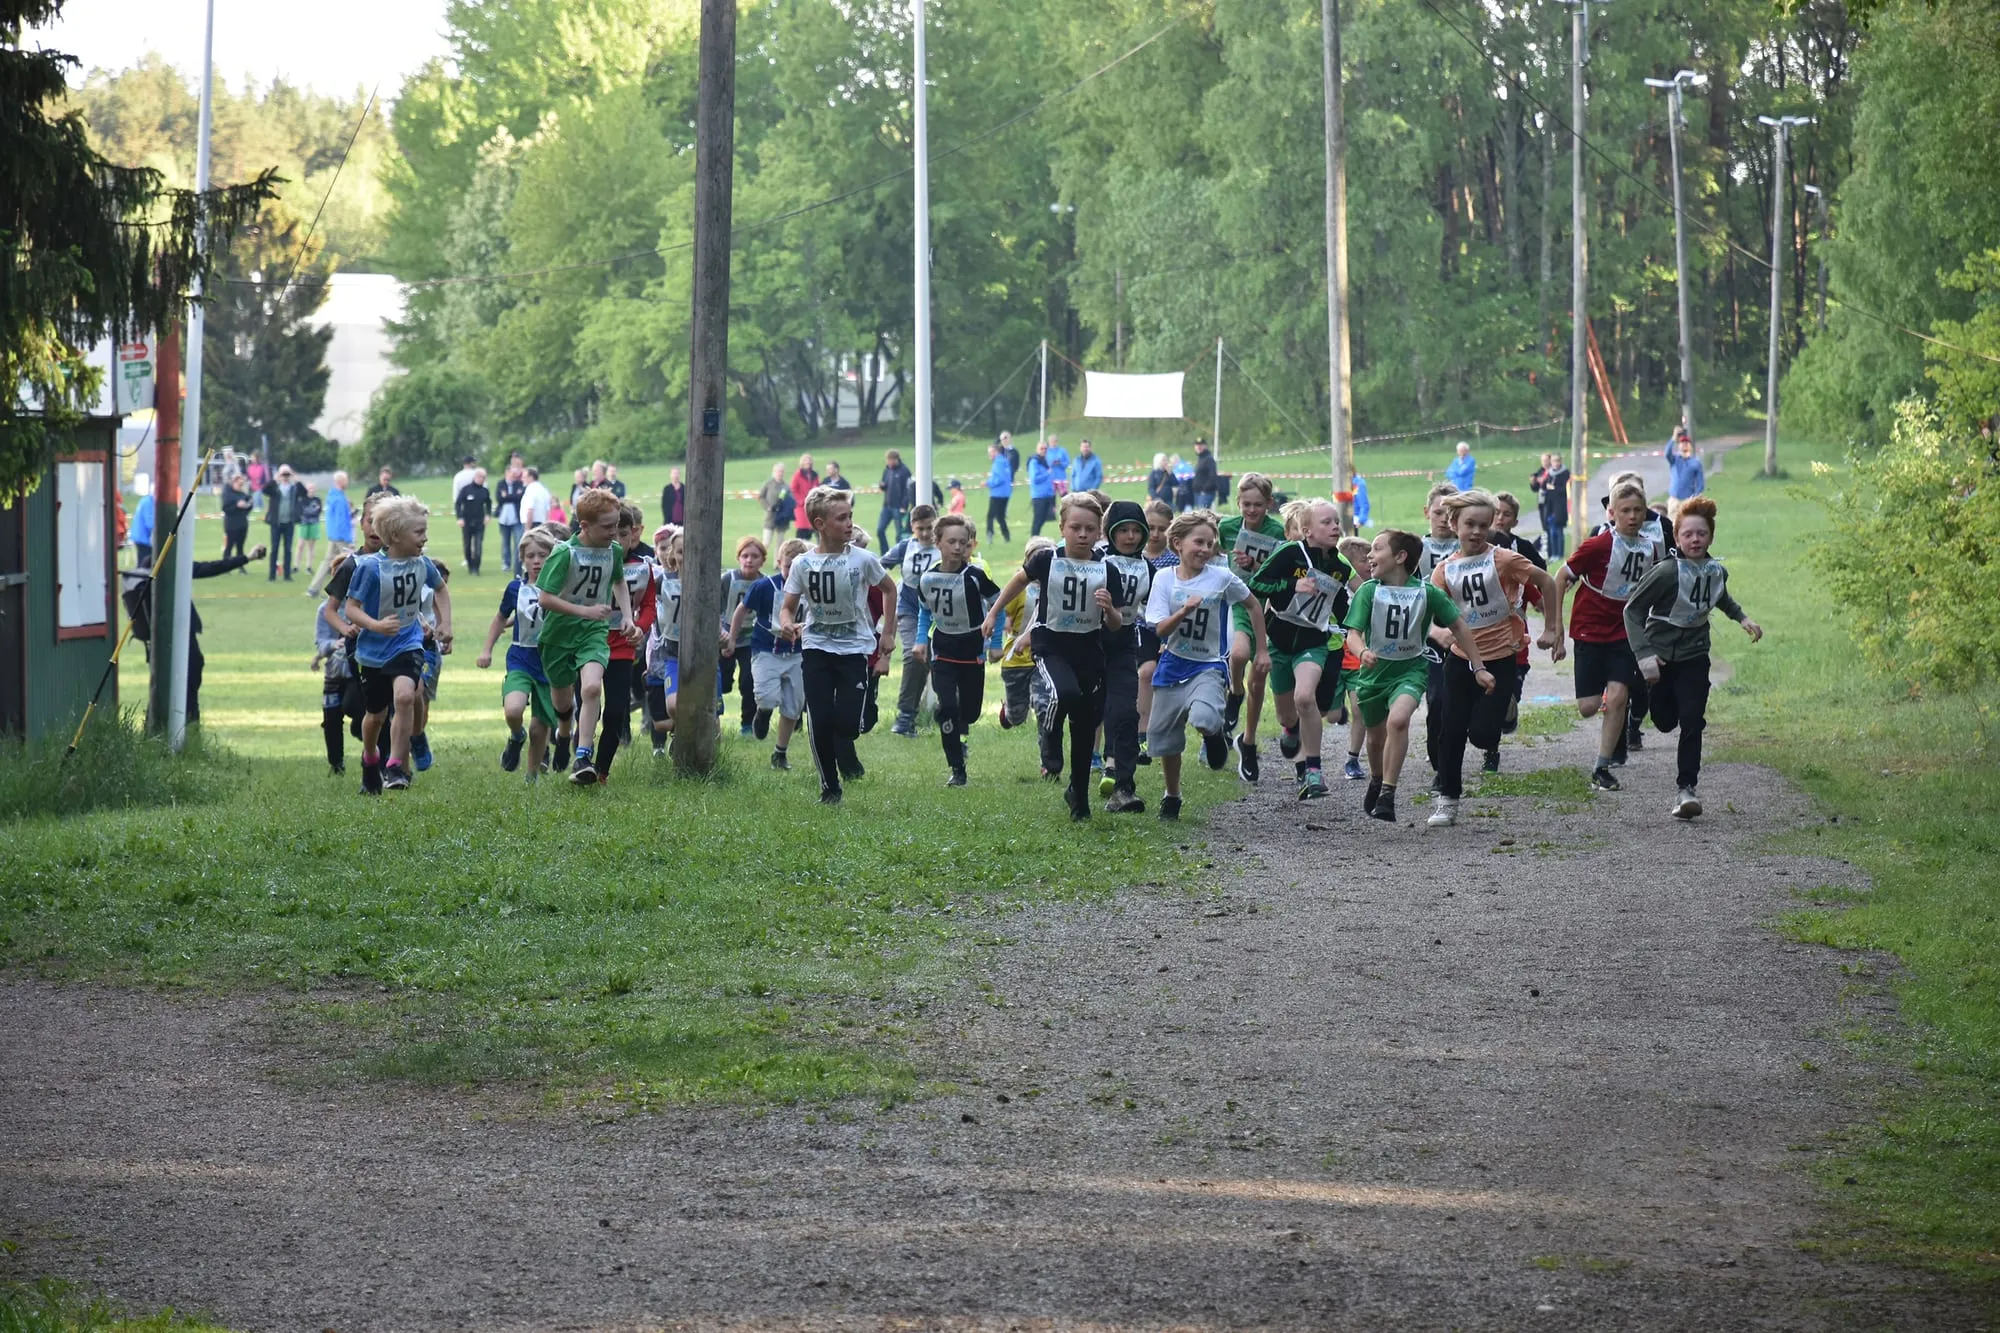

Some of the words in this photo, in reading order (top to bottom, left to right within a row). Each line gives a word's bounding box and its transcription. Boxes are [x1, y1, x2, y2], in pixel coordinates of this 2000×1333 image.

[572, 566, 602, 598] 79
[1621, 552, 1644, 582] 46
[393, 573, 417, 608] 82
[809, 571, 836, 603] 80
[931, 587, 953, 616] 73
[1063, 576, 1087, 612] 91
[1462, 573, 1489, 608] 49
[1690, 576, 1711, 610] 44
[1179, 608, 1209, 640] 59
[1385, 604, 1410, 640] 61
